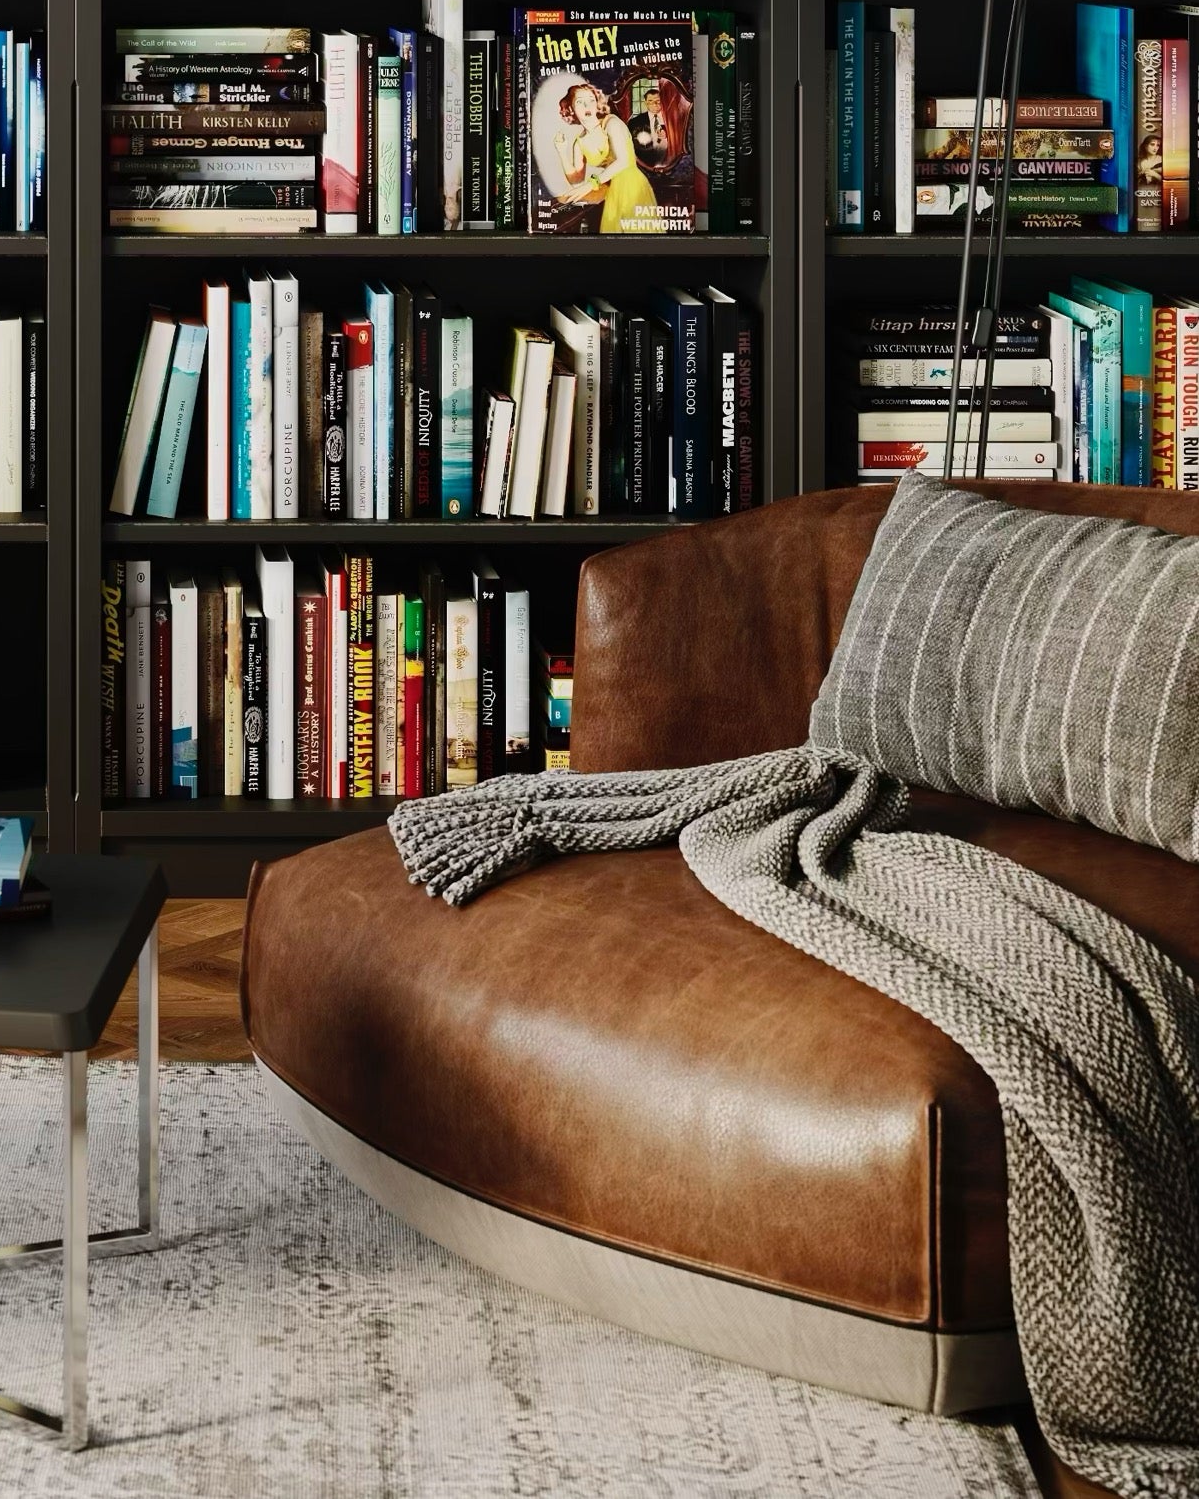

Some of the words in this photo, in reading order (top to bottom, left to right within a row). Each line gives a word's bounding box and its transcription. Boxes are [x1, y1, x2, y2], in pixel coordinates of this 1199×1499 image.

[571, 11, 585, 19] She
[590, 11, 611, 19] Knew
[615, 11, 629, 19] Too
[633, 11, 655, 19] Much
[659, 11, 668, 19] To
[673, 11, 691, 19] Live
[845, 18, 853, 38] THE
[141, 39, 156, 47] Call
[179, 39, 197, 47] Wild
[536, 34, 573, 64] the
[577, 26, 618, 59] KEY
[623, 39, 660, 54] unlocks
[665, 38, 681, 49] the
[845, 43, 853, 63] CAT
[156, 66, 180, 76] History
[220, 66, 253, 76] Astrology
[470, 52, 482, 80] THE
[540, 67, 561, 77] door
[567, 64, 576, 73] to
[581, 60, 614, 71] murder
[620, 56, 637, 66] and
[643, 52, 683, 64] violence
[845, 67, 853, 79] IN
[121, 93, 164, 103] Calling
[219, 84, 246, 93] Paul
[250, 84, 266, 93] M.
[219, 94, 271, 102] Strickler
[844, 81, 853, 104] THE
[470, 84, 482, 135] HOBBIT
[844, 106, 853, 127] HAT
[1020, 106, 1098, 116] BEETLEJUICE
[202, 117, 252, 128] KIRSTEN
[257, 117, 291, 128] KELLY
[727, 108, 736, 141] Name
[152, 138, 207, 148] Games
[212, 137, 271, 149] Hunger
[275, 139, 305, 149] The
[503, 135, 511, 161] LADY
[717, 128, 726, 152] your
[718, 154, 724, 165] of
[727, 143, 736, 184] Author
[1019, 162, 1092, 174] GANYMEDE
[712, 167, 724, 194] Title
[635, 206, 689, 217] PATRICIA
[620, 219, 691, 230] WENTWORTH
[686, 318, 697, 337] THE
[870, 318, 913, 333] kitap
[452, 330, 461, 360] Robinson
[874, 345, 888, 353] SIX
[890, 345, 933, 353] CENTURY
[1154, 307, 1176, 384] HARD
[1183, 335, 1199, 367] RUN
[686, 342, 696, 375] KING'S
[452, 363, 460, 387] Crusoe
[686, 378, 696, 415] BLOOD
[723, 352, 735, 447] MACBETH
[1153, 393, 1175, 419] IT
[1181, 374, 1199, 432] TOUGH,
[1183, 437, 1199, 466] RUN
[285, 423, 293, 506] PORCUPINE
[330, 466, 340, 496] HARPER
[330, 498, 340, 512] LEE
[102, 586, 124, 664] Death
[354, 644, 373, 701] BOOK
[101, 666, 115, 711] WISH
[483, 668, 496, 726] INIQUITY
[137, 703, 145, 786] PORCUPINE
[298, 710, 309, 780] HOGWARTS
[312, 712, 320, 766] HISTORY
[354, 714, 373, 797] MYSTERY
[312, 770, 319, 778] A
